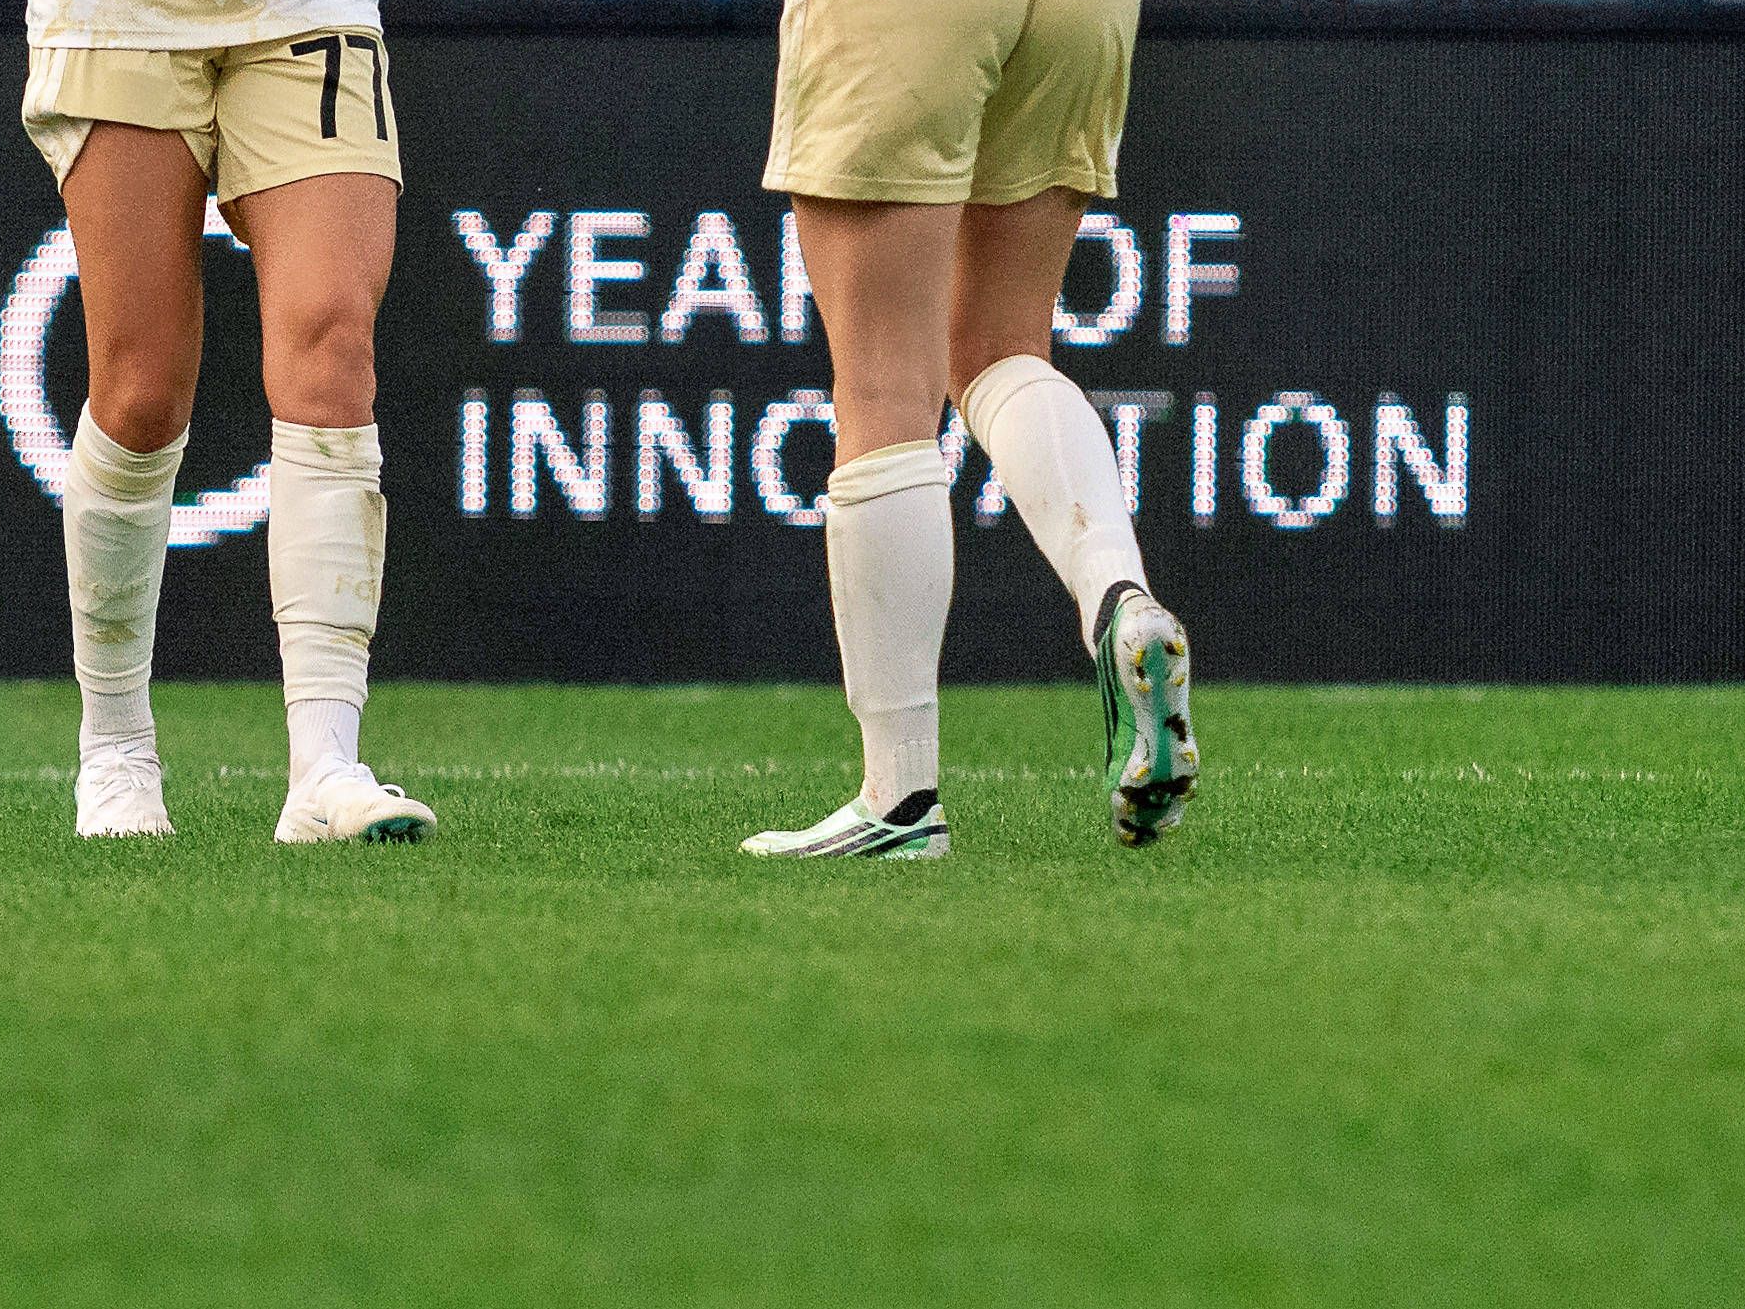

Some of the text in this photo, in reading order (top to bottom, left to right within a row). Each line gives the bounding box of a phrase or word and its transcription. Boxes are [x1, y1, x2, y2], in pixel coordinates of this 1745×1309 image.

[289, 34, 389, 142] 77
[453, 210, 1243, 345] YEA OF
[460, 390, 1470, 528] INNOTION
